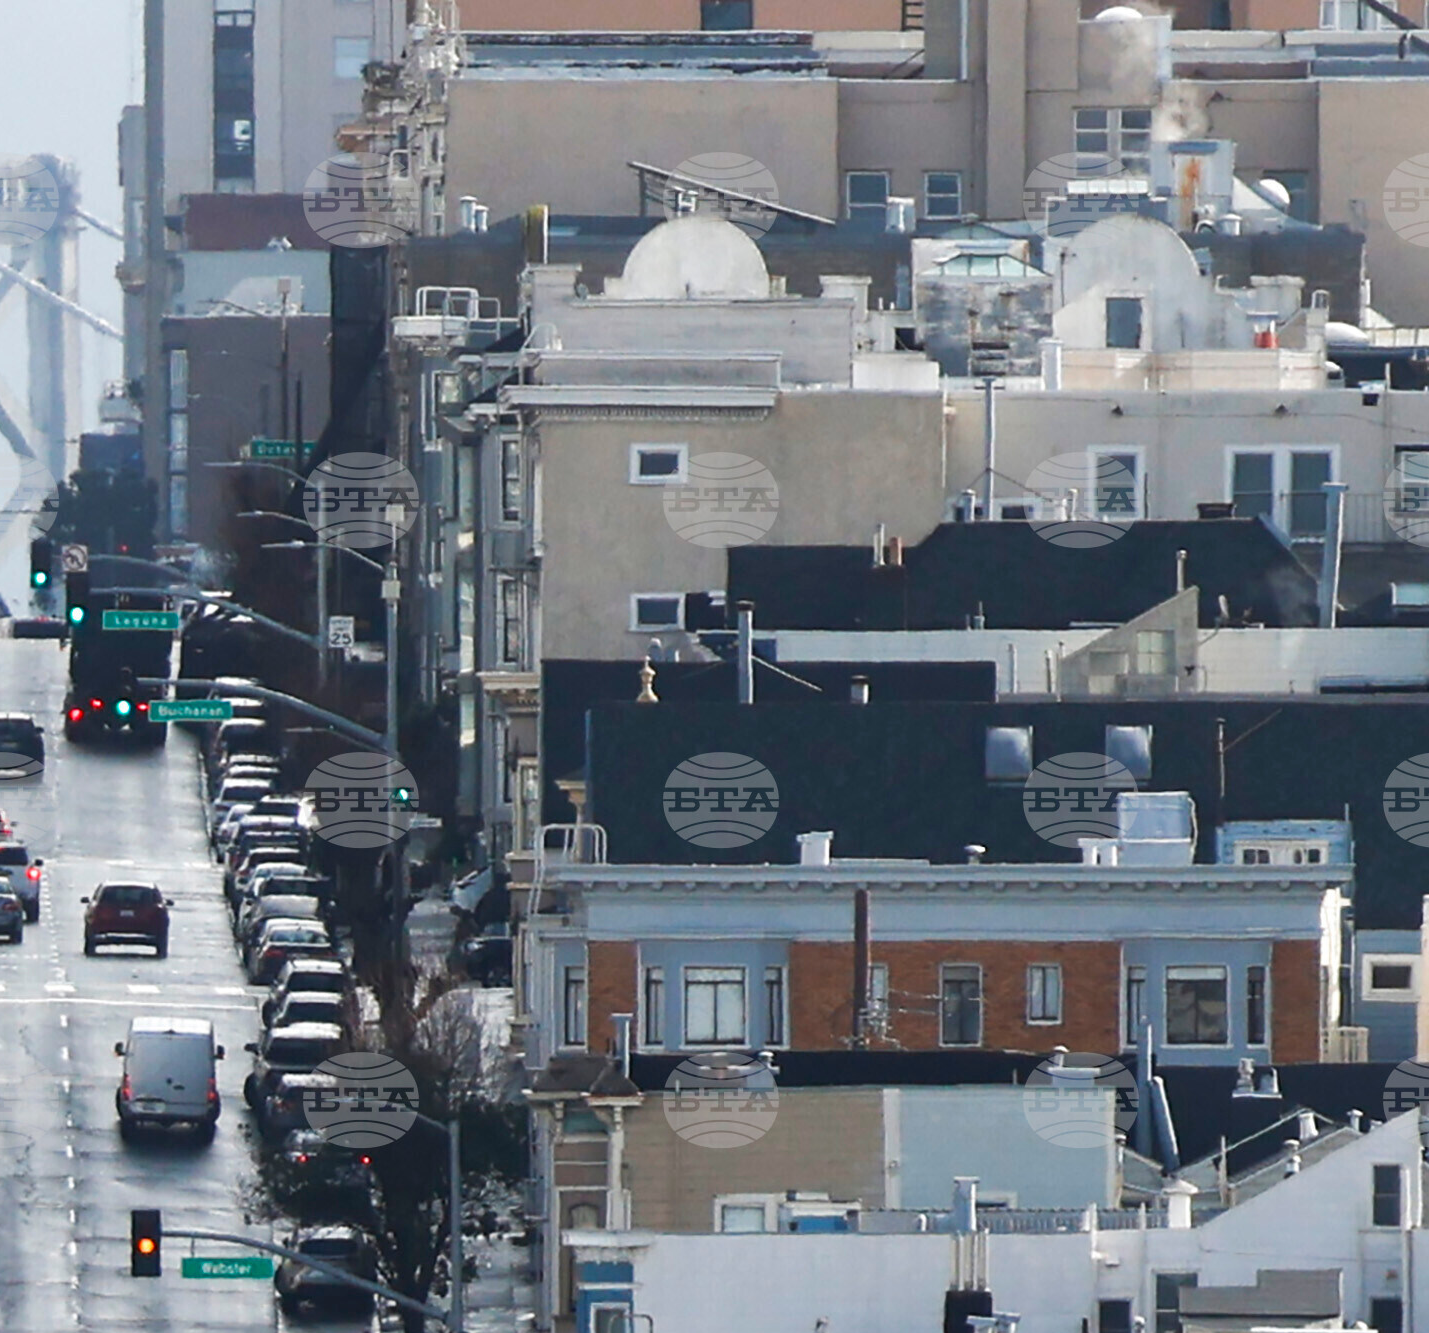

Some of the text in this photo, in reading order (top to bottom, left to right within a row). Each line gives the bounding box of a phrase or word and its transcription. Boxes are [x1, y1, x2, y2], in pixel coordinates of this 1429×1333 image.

[115, 615, 168, 627] Laguna
[330, 631, 352, 645] 25
[157, 704, 225, 717] Buchanan
[202, 1262, 251, 1275] Webster
